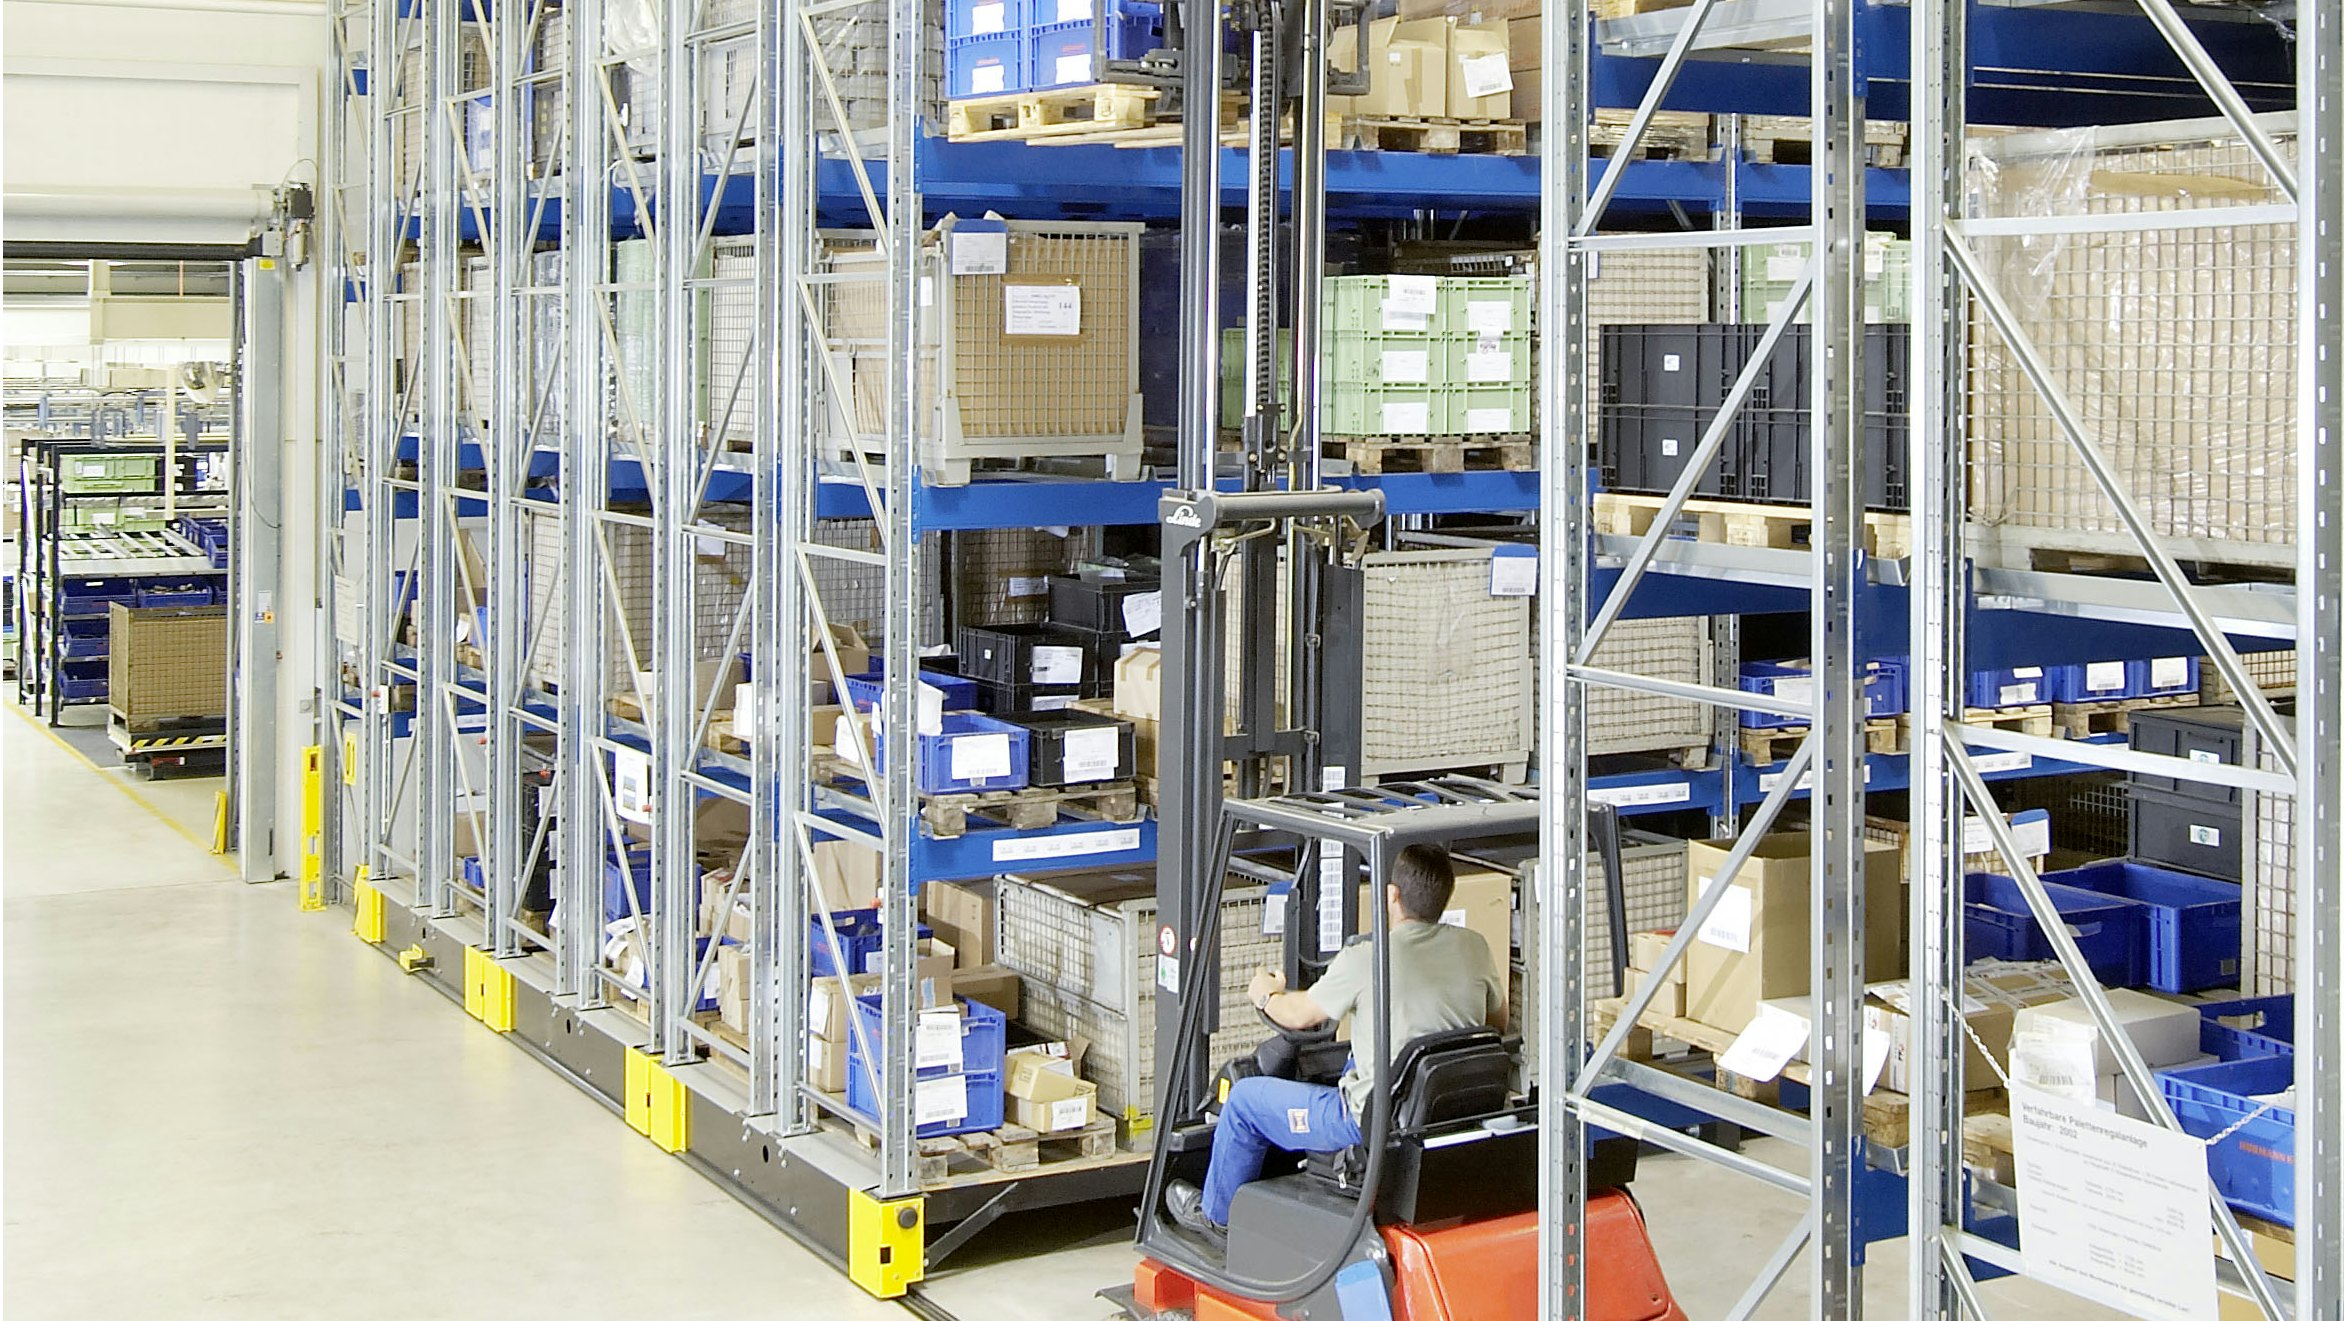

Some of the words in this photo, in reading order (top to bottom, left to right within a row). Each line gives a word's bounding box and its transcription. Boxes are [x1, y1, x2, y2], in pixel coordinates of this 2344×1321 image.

[1166, 505, 1201, 528] Linde
[2021, 1102, 2066, 1122] Verfahrbare
[2059, 1126, 2078, 1139] 2002
